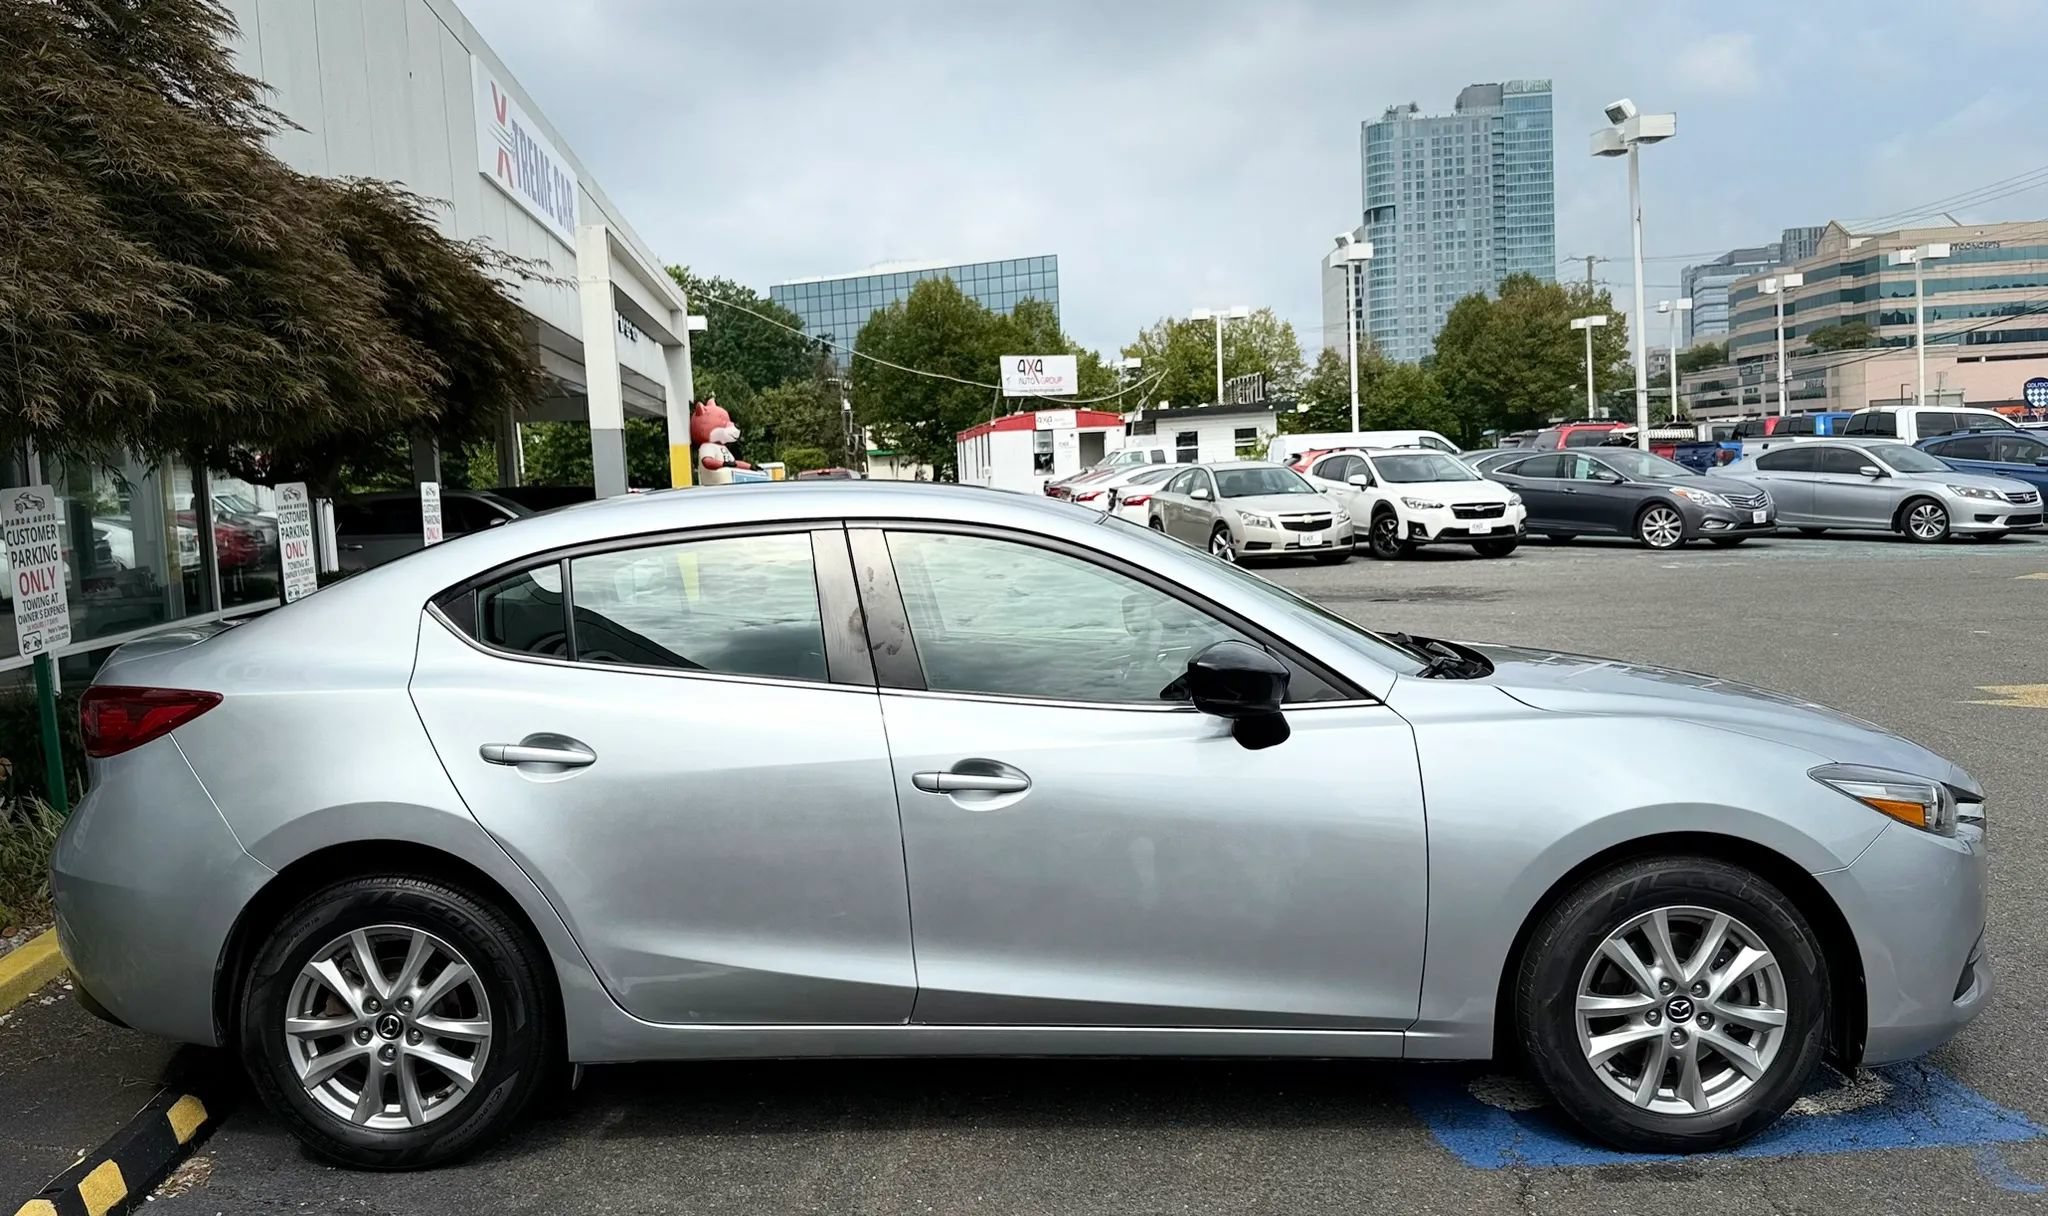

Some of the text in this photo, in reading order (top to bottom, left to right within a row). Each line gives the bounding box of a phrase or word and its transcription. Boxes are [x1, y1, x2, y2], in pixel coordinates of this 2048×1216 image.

[553, 165, 575, 236] CAR
[1040, 376, 1063, 385] GROUP
[5, 513, 56, 527] PANDA AUTOS
[278, 510, 309, 525] CUSTOMER
[6, 524, 57, 547] CUSTOMER
[281, 523, 310, 540] PARKING
[10, 543, 58, 569] PARKING
[285, 539, 308, 560] ONLY
[19, 565, 56, 596] ONLY
[22, 592, 59, 612] TOWING AT
[43, 603, 66, 618] EXPENSE
